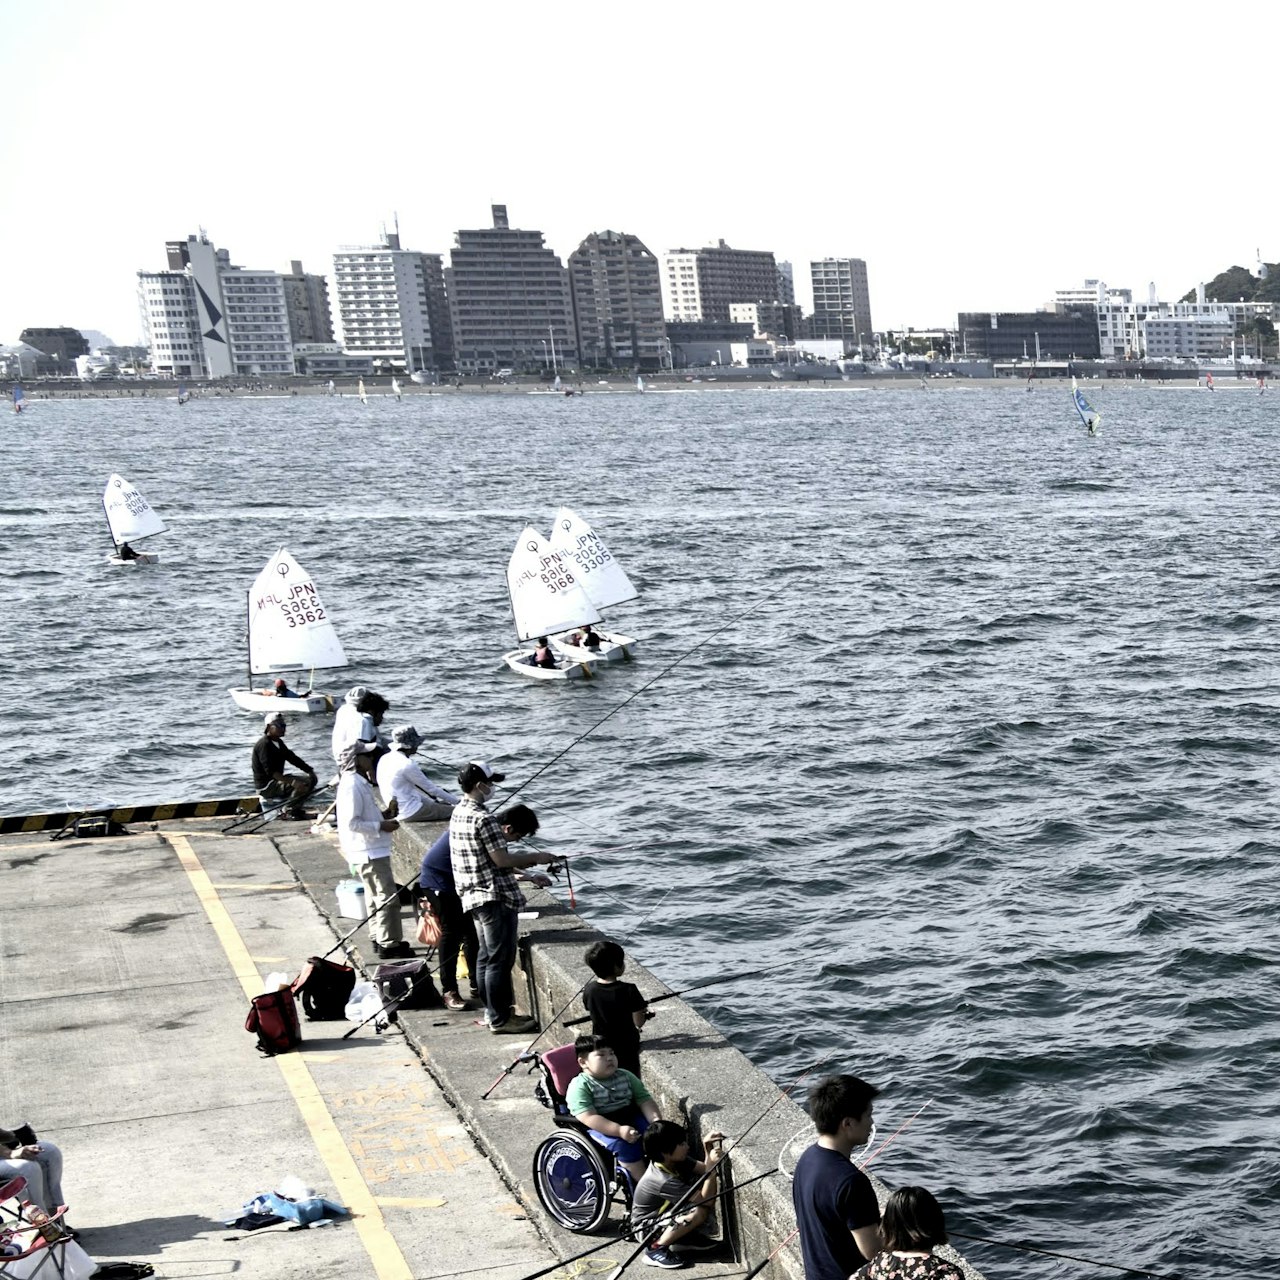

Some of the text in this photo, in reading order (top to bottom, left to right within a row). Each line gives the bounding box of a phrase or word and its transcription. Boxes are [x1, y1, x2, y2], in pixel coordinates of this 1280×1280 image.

[124, 491, 138, 502] JPN
[576, 531, 597, 550] JPN
[540, 552, 562, 572] JPN
[581, 551, 611, 573] 3305
[287, 583, 316, 600] JPN
[547, 574, 575, 594] 3168
[286, 608, 326, 628] 3362
